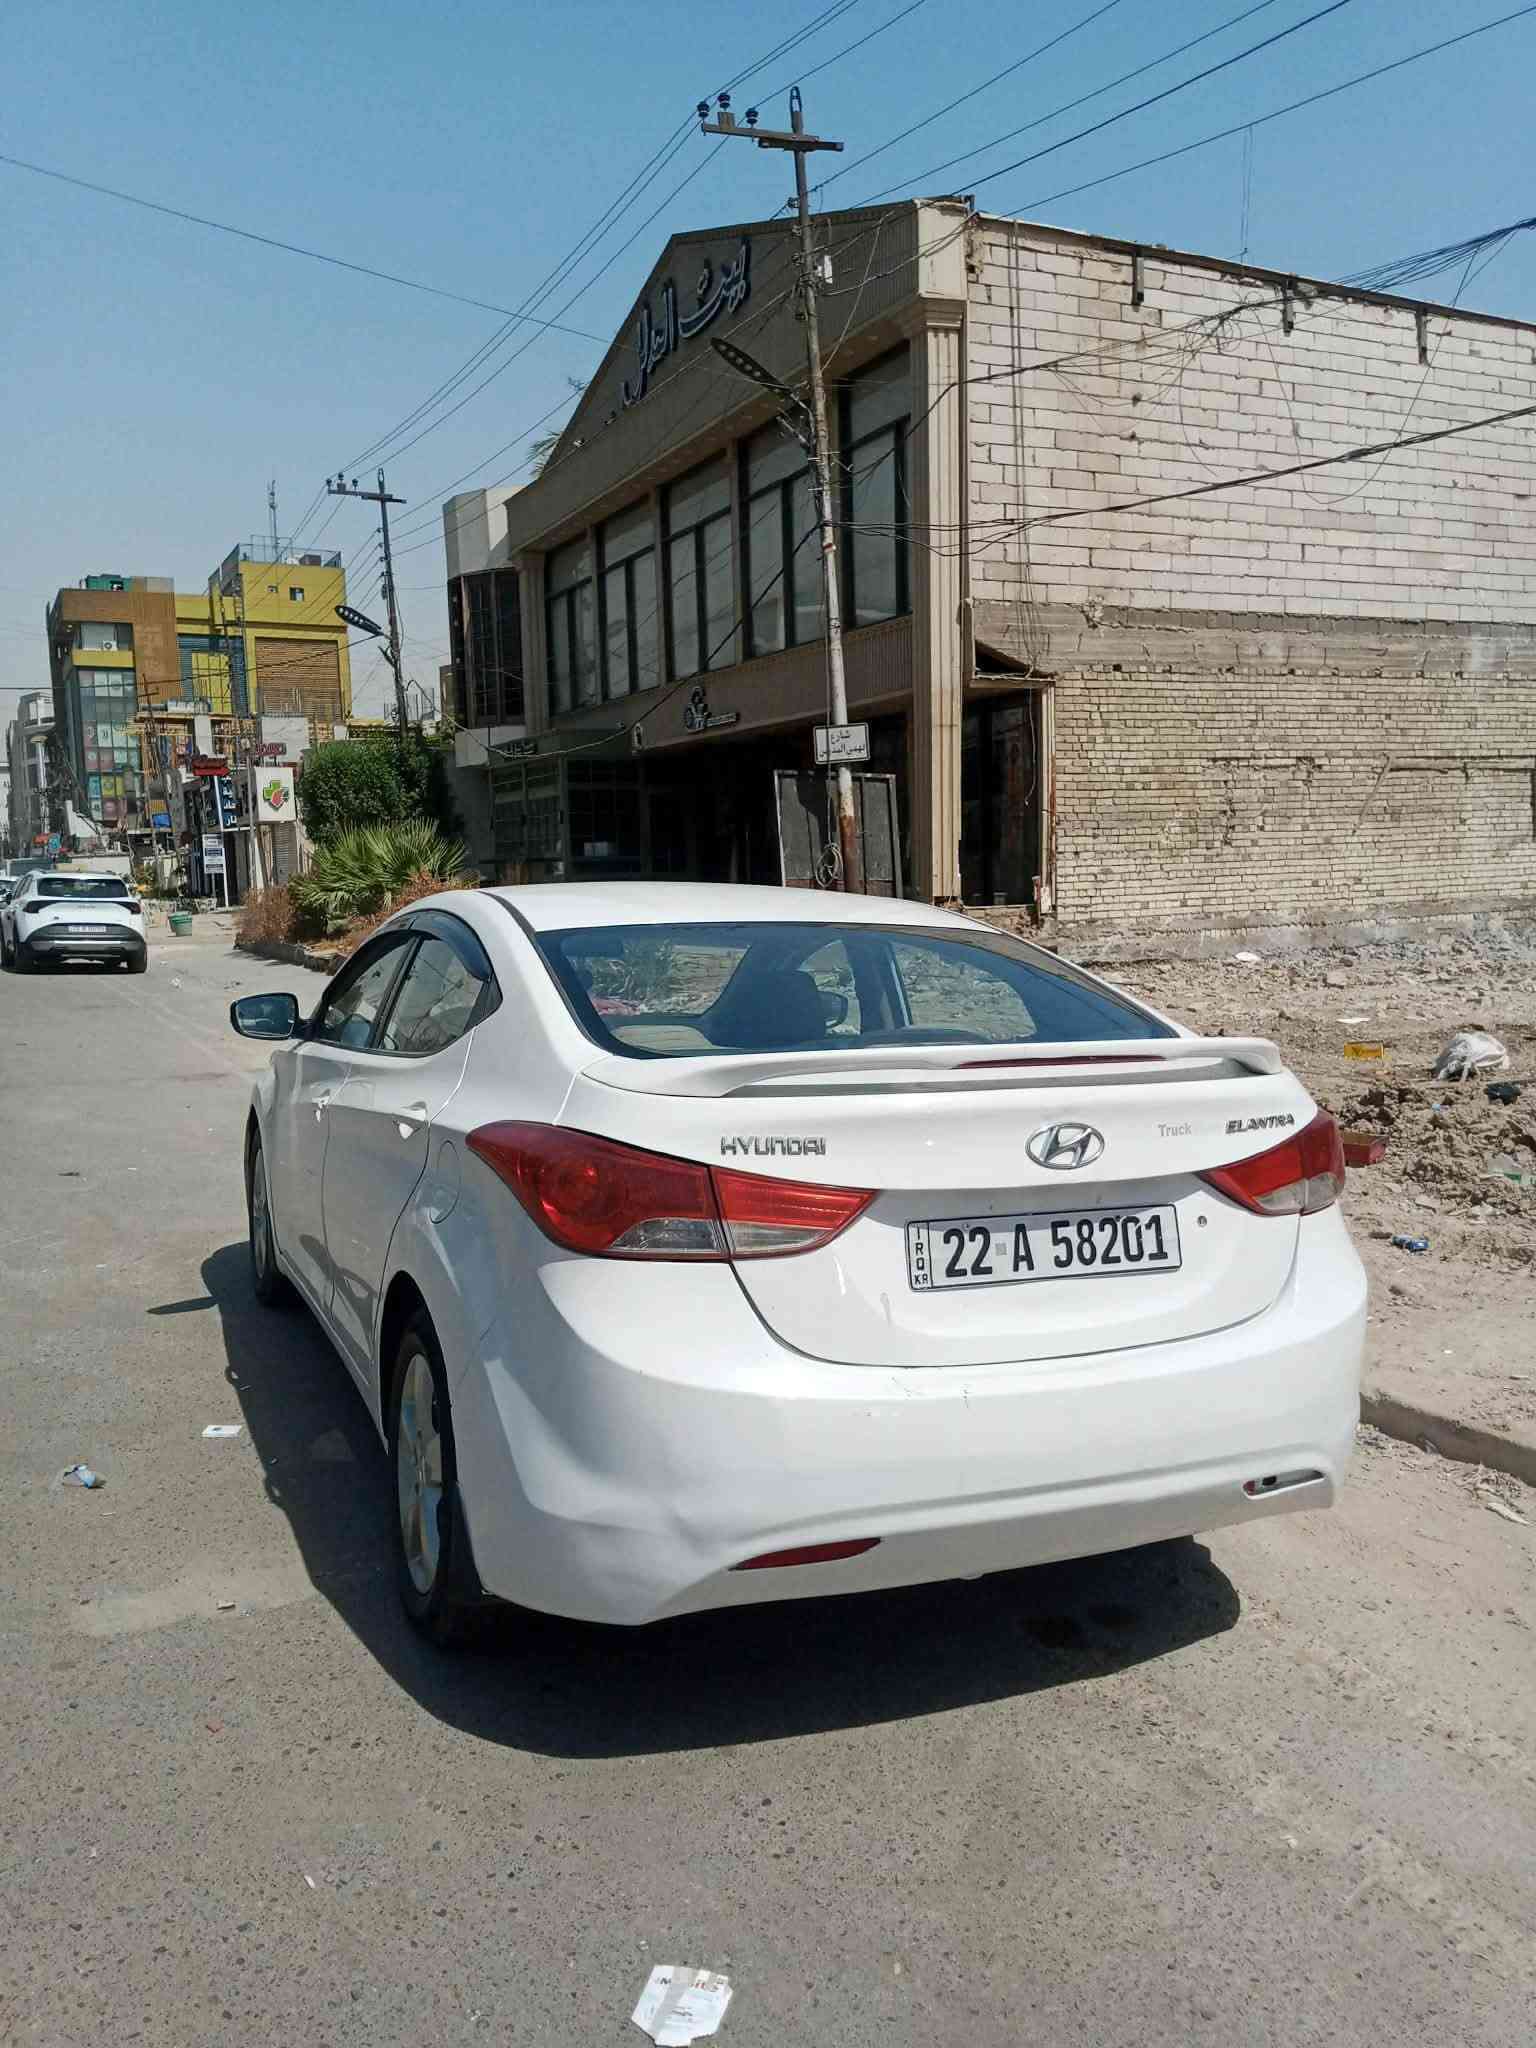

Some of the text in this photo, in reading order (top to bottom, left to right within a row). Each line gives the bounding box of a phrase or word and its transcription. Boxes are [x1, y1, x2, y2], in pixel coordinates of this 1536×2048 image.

[1157, 1122, 1192, 1137] Truck
[1225, 1113, 1296, 1134] ELANTRA
[720, 1136, 826, 1156] HYUNDAI
[942, 1214, 1169, 1278] 22 A 58201
